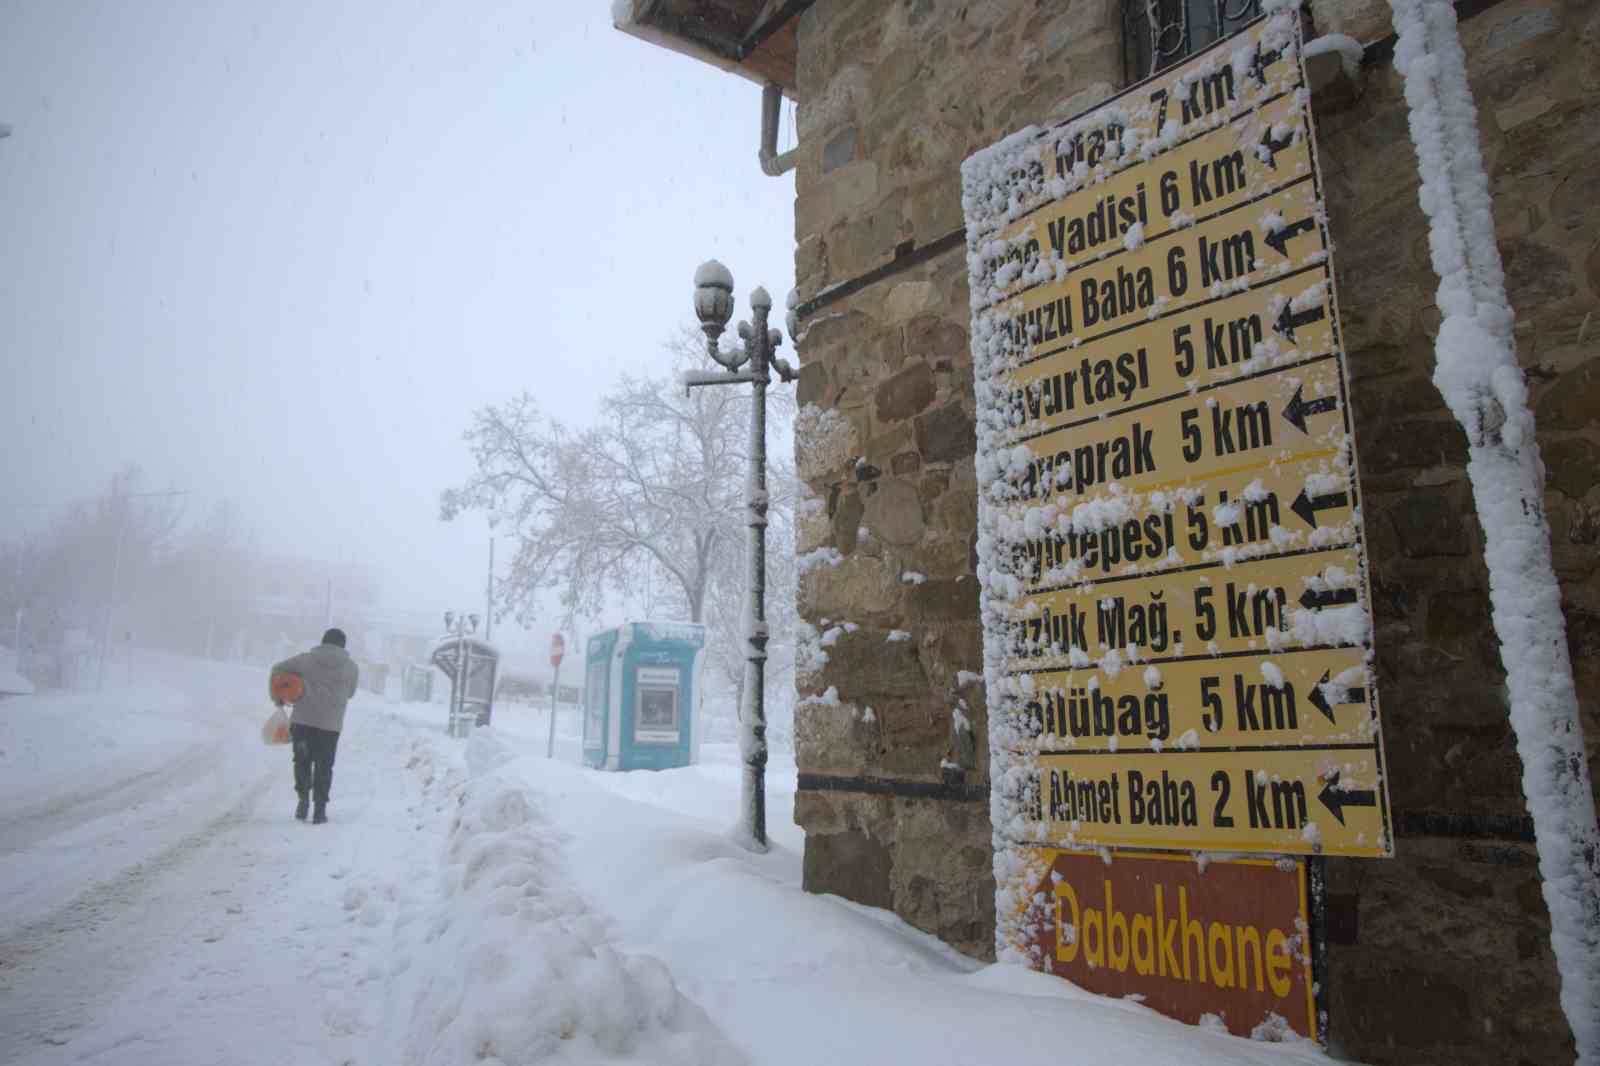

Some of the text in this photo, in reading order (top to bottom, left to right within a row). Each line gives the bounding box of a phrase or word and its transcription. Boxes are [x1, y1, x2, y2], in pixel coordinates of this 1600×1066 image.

[1151, 88, 1168, 138] 7
[1179, 63, 1236, 126] km
[1048, 182, 1147, 260] Vadisi
[1159, 170, 1180, 217] 6
[1189, 150, 1246, 207] km
[1081, 265, 1154, 328] Baba
[1167, 246, 1187, 297] 6
[1199, 230, 1256, 288] km
[1173, 324, 1194, 378] 5
[1204, 313, 1262, 370] km
[1181, 408, 1202, 463] 5
[1212, 400, 1272, 457] km
[1187, 495, 1208, 551] 5
[1219, 490, 1280, 546] km
[1097, 590, 1181, 653] Mağ.
[1194, 586, 1216, 641] 5
[1226, 582, 1288, 639] km
[1200, 676, 1223, 733] 5
[1234, 673, 1298, 732] km
[1050, 769, 1121, 825] Ahmet
[1127, 770, 1197, 826] Baba
[1211, 770, 1234, 828] 2
[1245, 770, 1308, 830] km
[1055, 879, 1291, 998] Dabakhane
